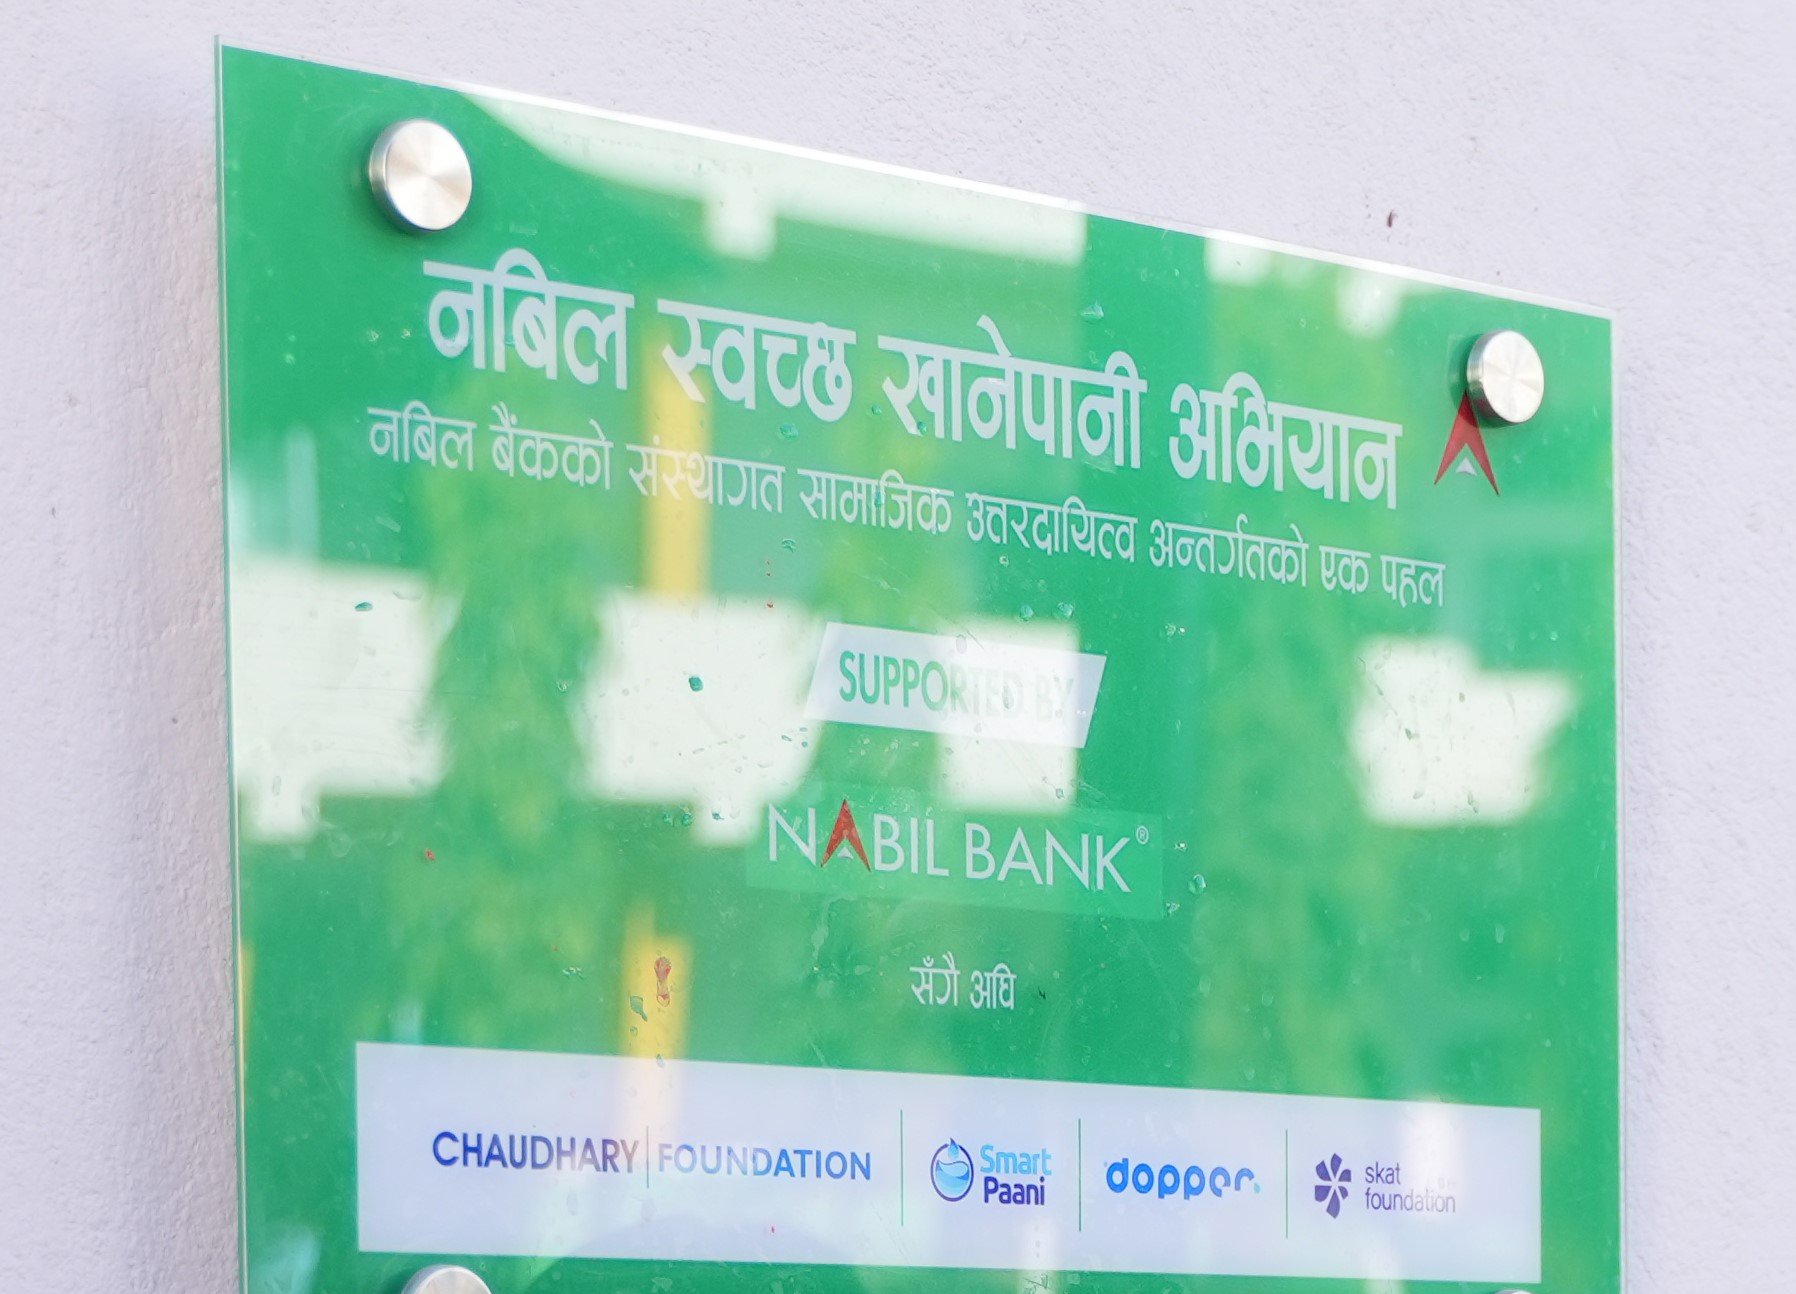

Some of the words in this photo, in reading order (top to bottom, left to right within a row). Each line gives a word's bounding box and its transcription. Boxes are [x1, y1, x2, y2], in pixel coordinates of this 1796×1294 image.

[423, 247, 635, 391] नबिल
[657, 299, 857, 422] स्वच्छ
[877, 314, 1149, 469] खानेपानी
[1168, 371, 1403, 510] अभियान
[367, 400, 477, 472] नबिल
[489, 401, 614, 491] बैंकको
[626, 435, 786, 514] संस्थागत
[797, 467, 955, 536] सामाजिक
[964, 490, 1138, 564] उत्तरदायित्व
[1149, 514, 1309, 588] अन्तर्गतको
[1319, 545, 1371, 596] एक
[1381, 558, 1446, 608] पहल
[839, 649, 1023, 720] SUPPORTED
[768, 799, 950, 877] NABIL
[909, 951, 960, 1007] सँगै
[432, 1130, 640, 1174] CHAUDHARY
[659, 1142, 872, 1181] FOUNDATION
[980, 1143, 1052, 1176] Smart
[1365, 1161, 1400, 1185] skat
[983, 1175, 1046, 1206] Paani
[1365, 1187, 1456, 1213] foundation
